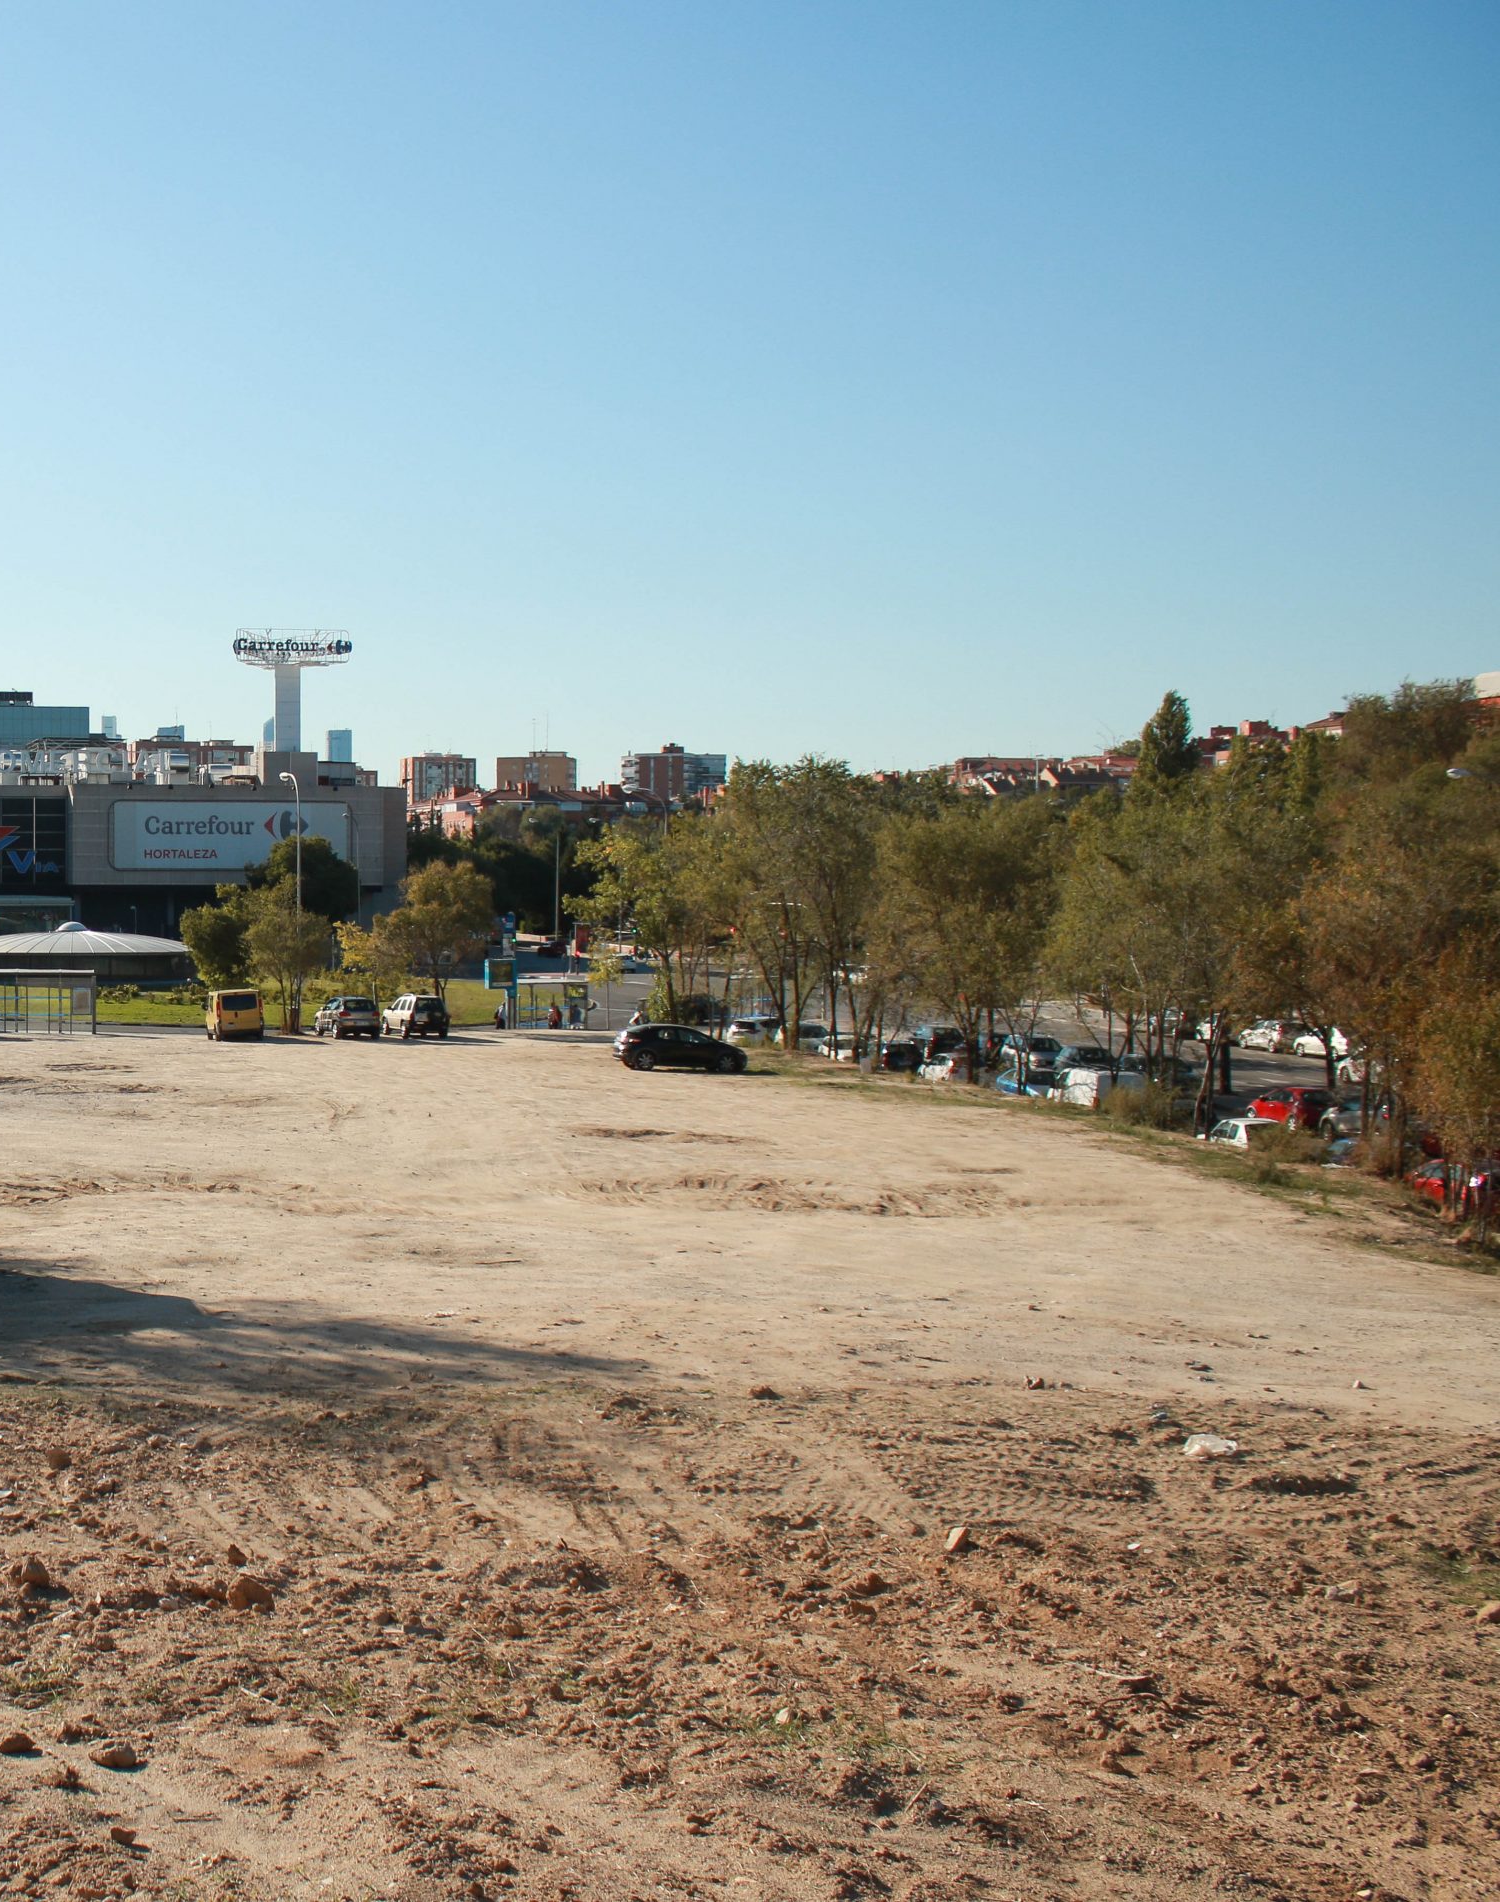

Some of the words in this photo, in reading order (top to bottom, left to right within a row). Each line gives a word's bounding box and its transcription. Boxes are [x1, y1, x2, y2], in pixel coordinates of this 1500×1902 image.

[237, 638, 320, 652] Carrefour
[144, 814, 255, 836] Carrefour
[143, 849, 219, 860] HORTALEZA
